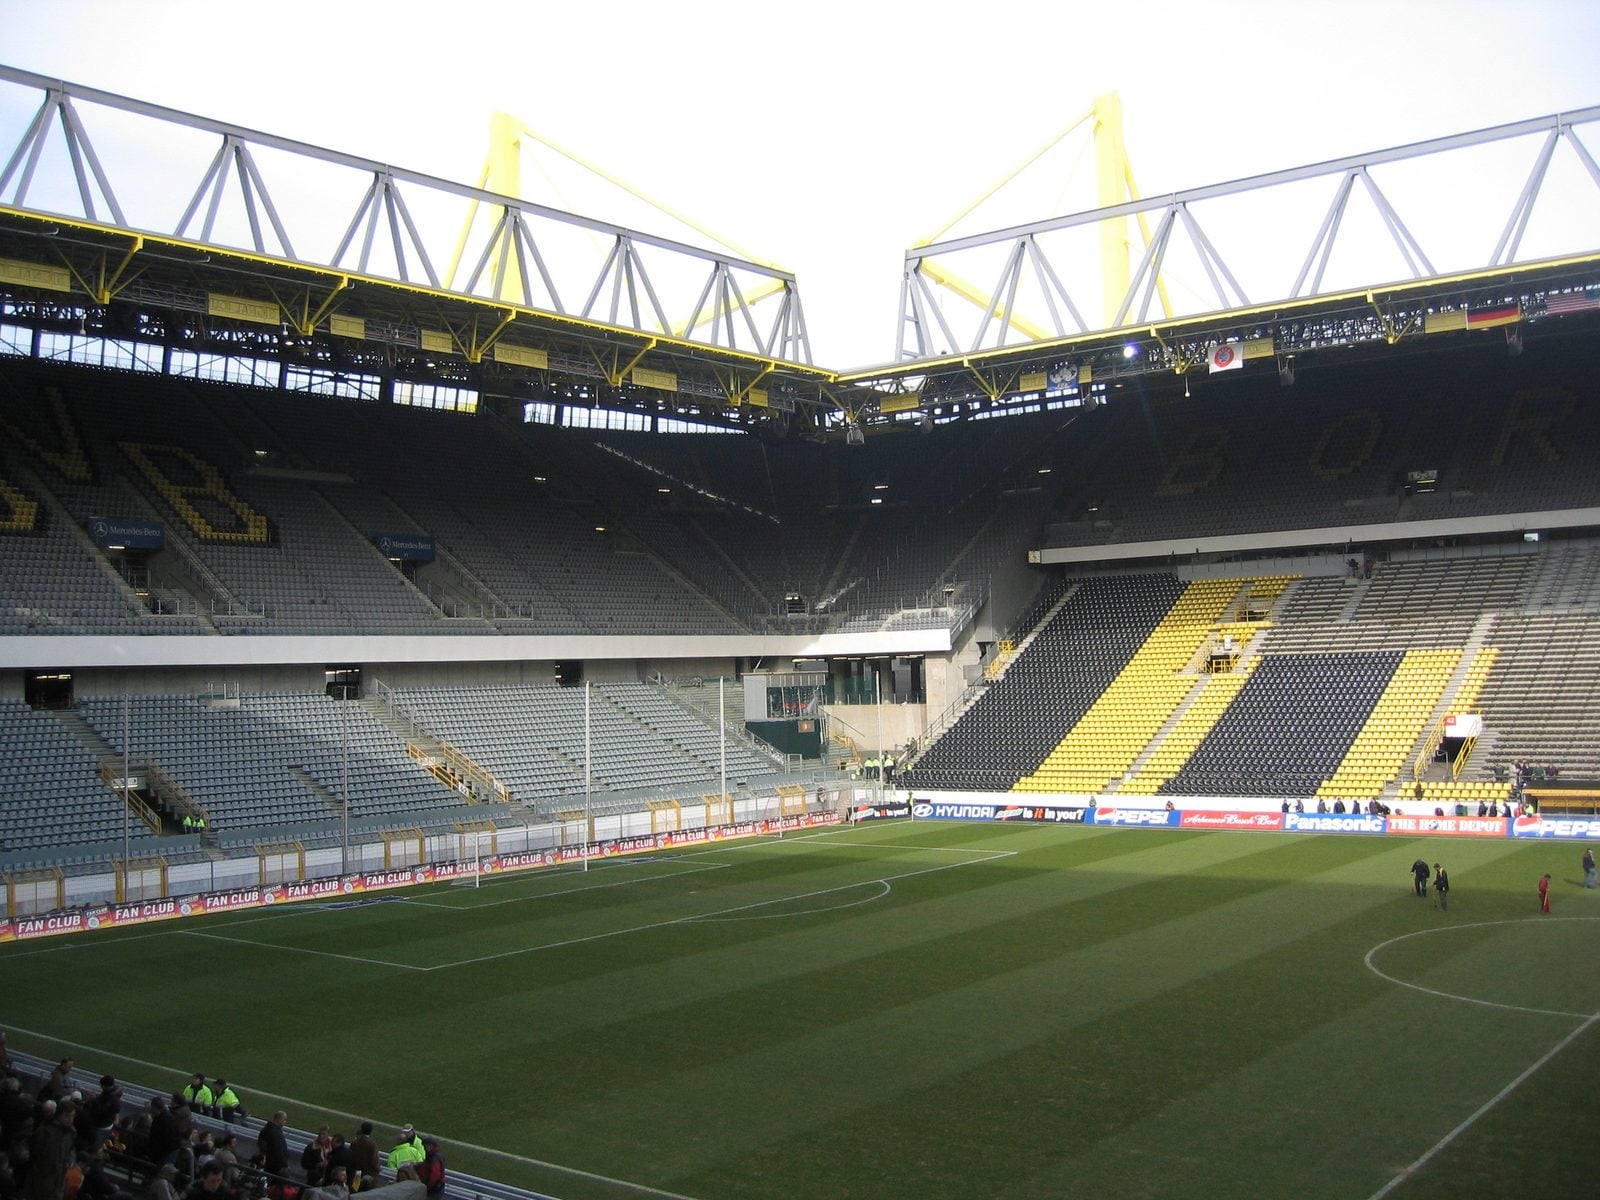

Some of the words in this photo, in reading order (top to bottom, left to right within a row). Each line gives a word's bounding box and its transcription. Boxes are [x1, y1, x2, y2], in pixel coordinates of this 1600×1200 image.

[110, 526, 161, 537] Mercedes-Benz
[812, 815, 823, 823] FAN
[824, 813, 839, 821] CLUB
[935, 805, 995, 818] HYUNDAI
[1033, 807, 1044, 820] it
[1045, 807, 1056, 820] in
[1056, 808, 1085, 822] you?
[1115, 810, 1169, 824] PEPSI
[769, 821, 780, 830] FAN
[782, 818, 797, 828] CLUB
[1224, 814, 1255, 825] Busch
[1285, 814, 1383, 831] Panasonic
[1390, 818, 1416, 830] THE
[1419, 819, 1456, 831] HOME
[1459, 820, 1503, 833] DEPOT
[722, 827, 735, 836] FAN
[737, 823, 753, 834] CLUB
[1538, 820, 1600, 836] PEPS
[672, 834, 686, 843] FAN
[687, 831, 706, 841] CLUB
[620, 841, 634, 851] FAN
[635, 838, 654, 848] CLUB
[503, 857, 519, 867] FAN
[520, 853, 542, 864] CLUB
[563, 848, 577, 858] FAN
[436, 865, 453, 876] FAN
[366, 875, 385, 886] FAN
[387, 871, 412, 883] CLUB
[288, 885, 308, 897] FAN
[312, 880, 339, 893] CLUB
[207, 896, 228, 908] FAN
[231, 891, 259, 903] CLUB
[115, 907, 139, 920] FAN
[143, 902, 175, 915] CLUB
[18, 919, 44, 933] FAN
[48, 915, 81, 929] CLUB
